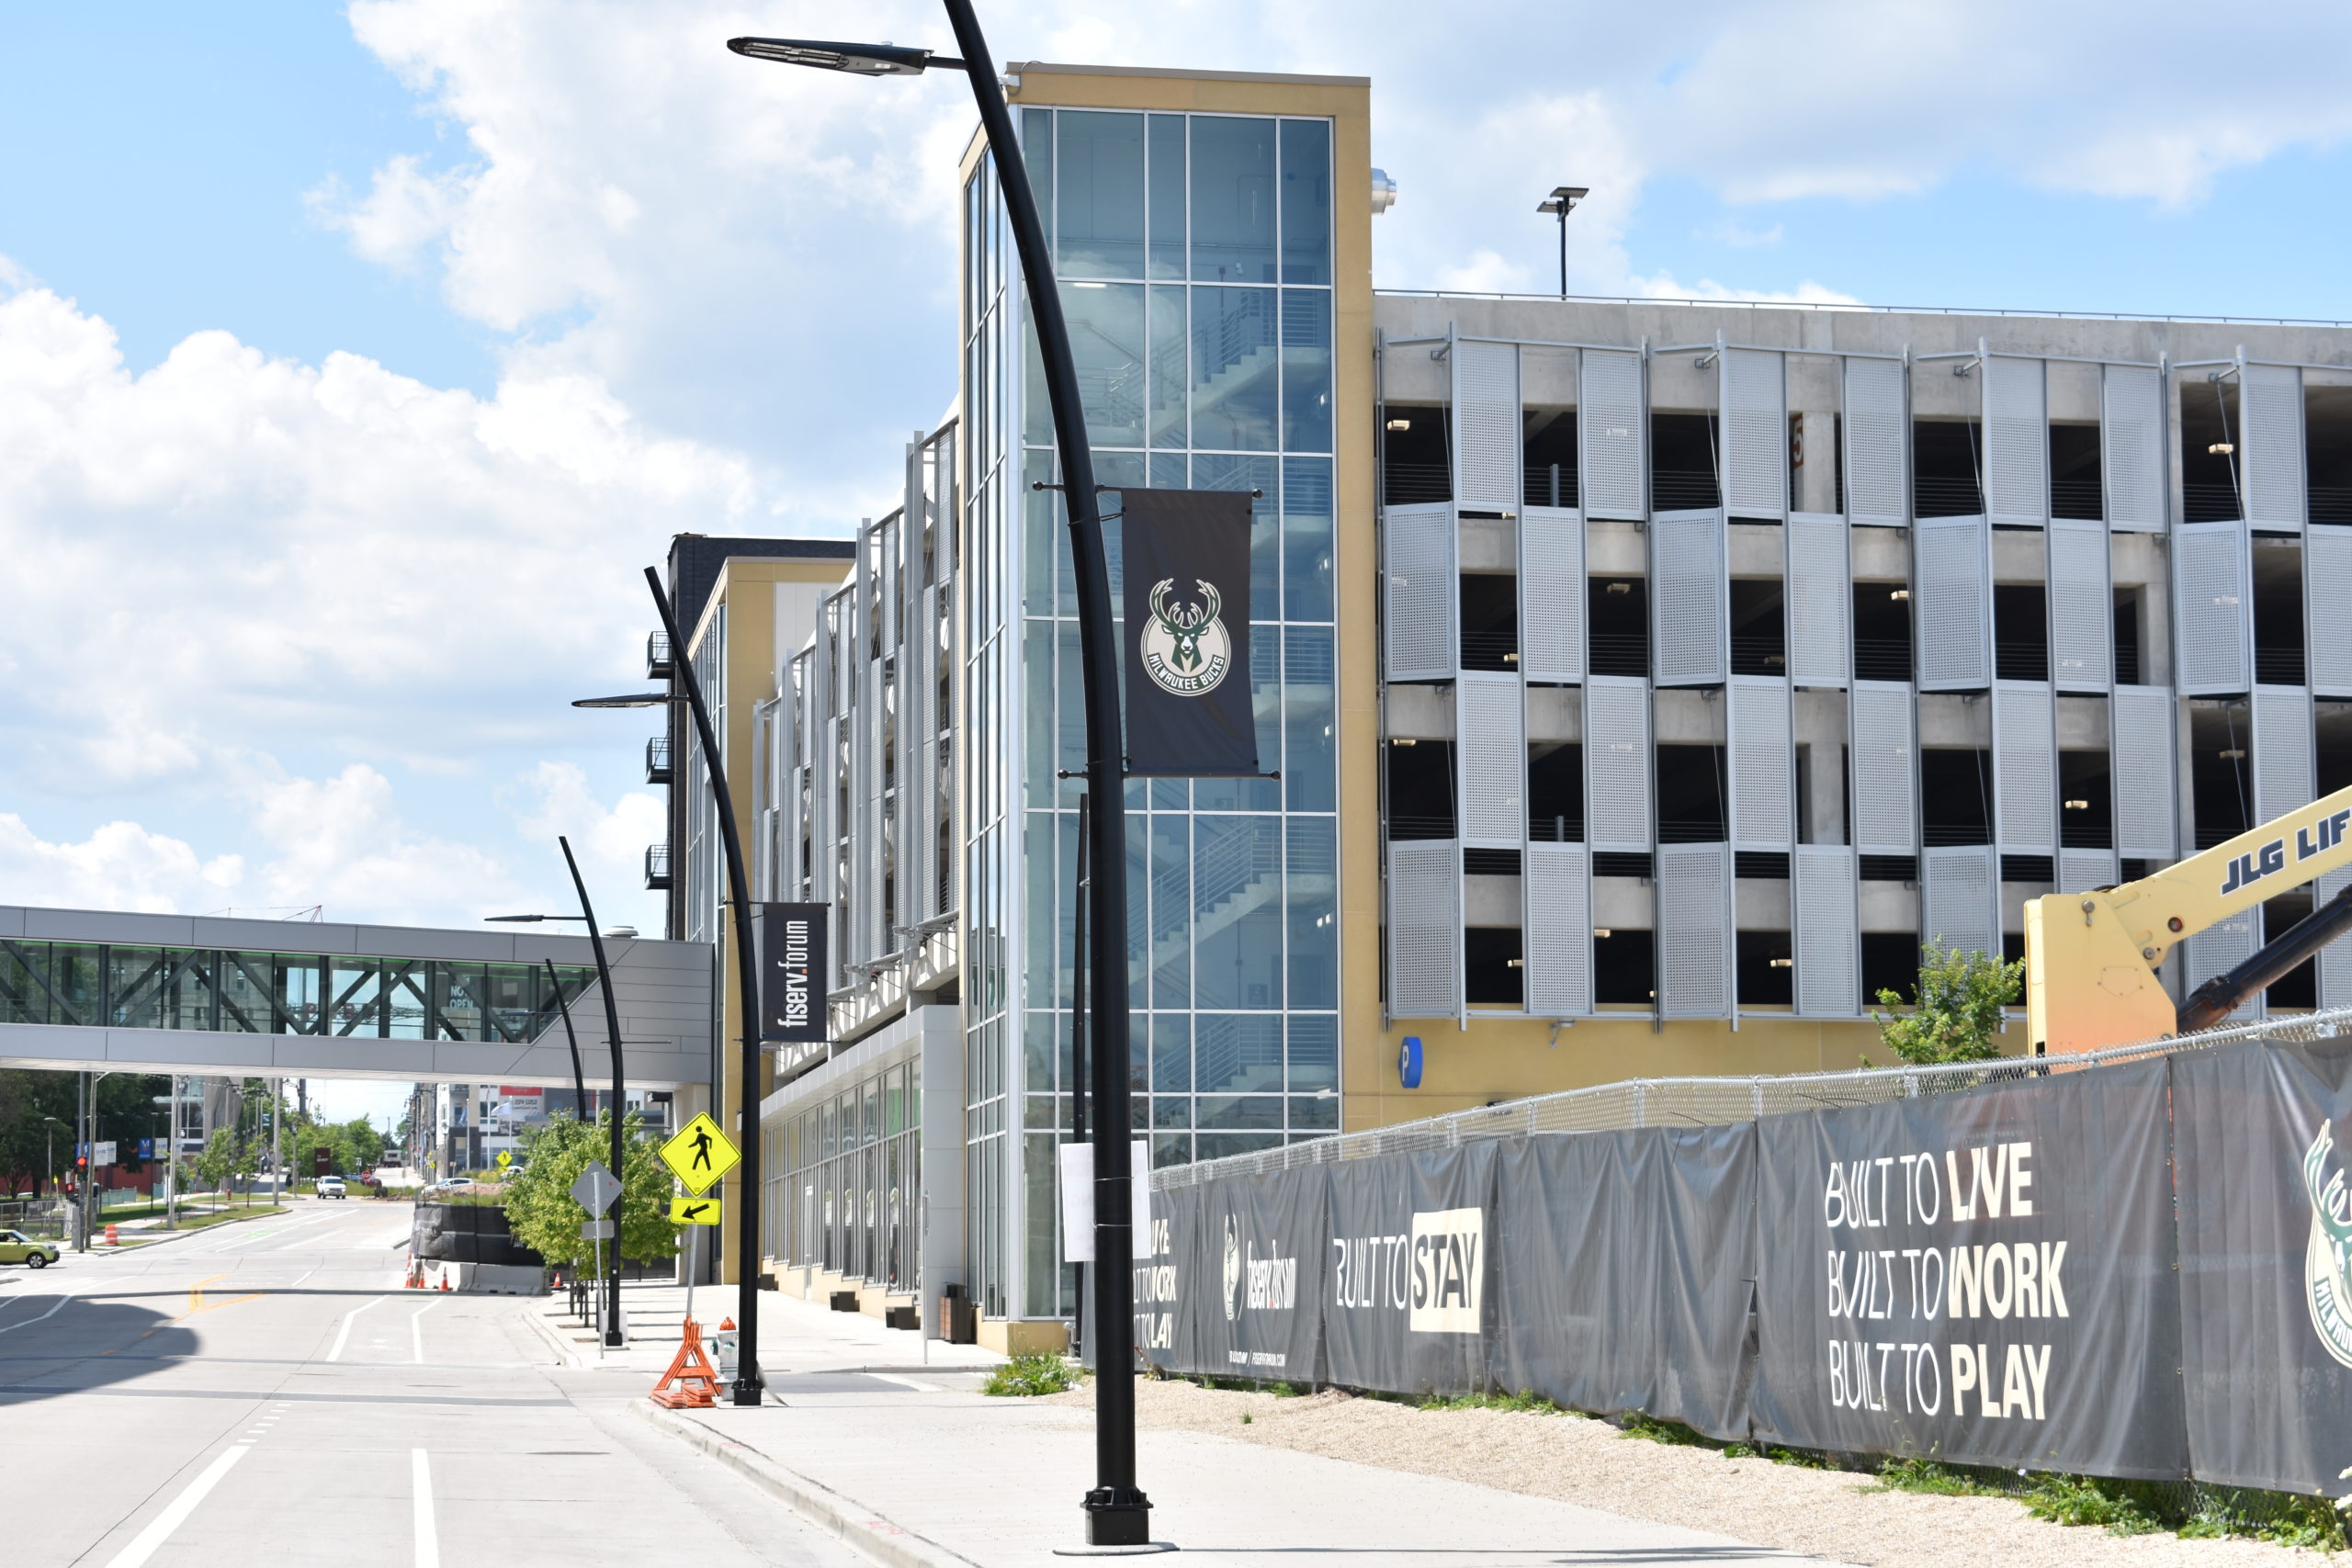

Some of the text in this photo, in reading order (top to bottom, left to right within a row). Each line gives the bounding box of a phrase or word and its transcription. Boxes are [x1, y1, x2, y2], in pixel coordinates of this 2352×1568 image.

[1148, 654, 1224, 690] MILWAUKEE BUCKS
[2220, 807, 2352, 897] JLG LIF
[450, 985, 468, 998] NO
[450, 998, 473, 1009] OPEN
[1402, 1044, 1409, 1082] P
[1825, 1142, 2032, 1229] BUILT TO LIVE
[1384, 1235, 1409, 1310] TO
[1413, 1233, 1477, 1310] STAY
[1828, 1241, 2069, 1320] BUILT TO WORK
[1829, 1339, 2052, 1420] BUILT TO PLAY
